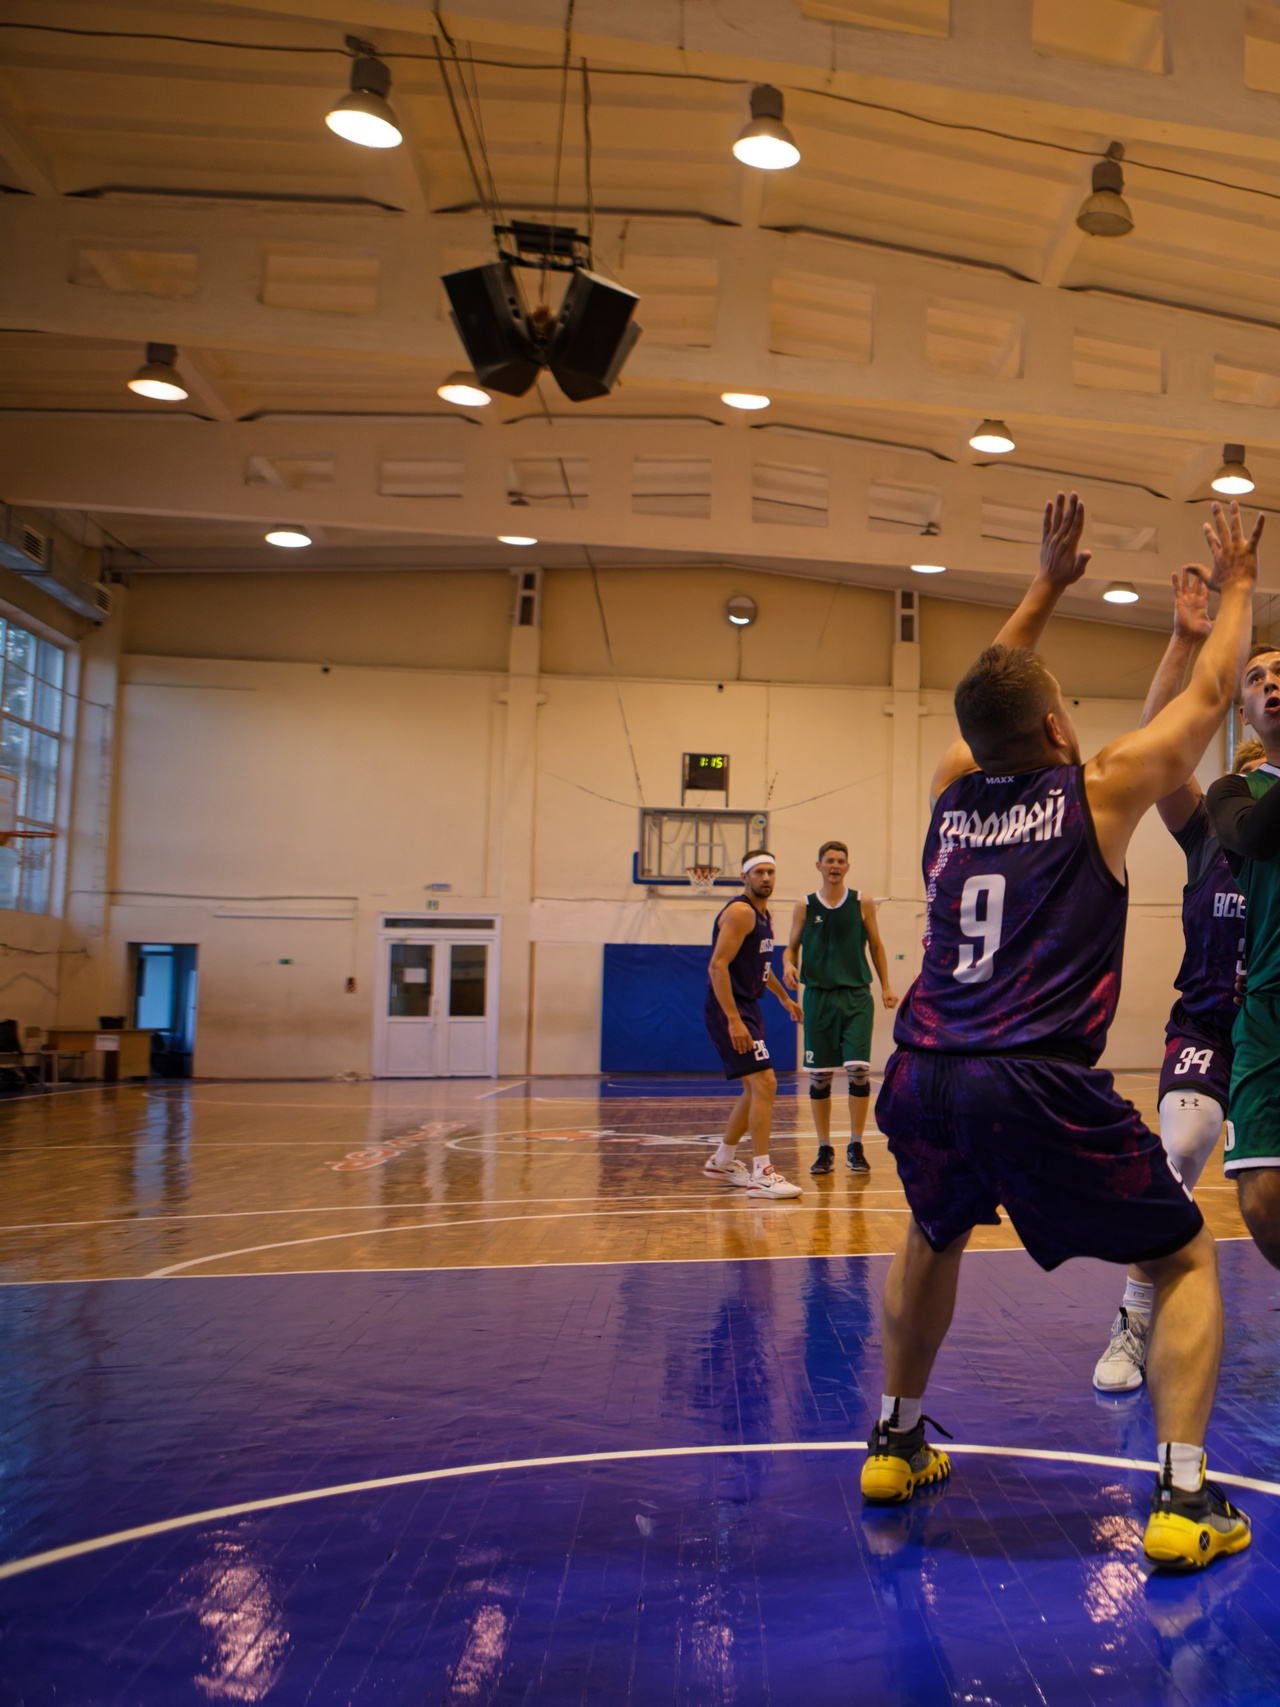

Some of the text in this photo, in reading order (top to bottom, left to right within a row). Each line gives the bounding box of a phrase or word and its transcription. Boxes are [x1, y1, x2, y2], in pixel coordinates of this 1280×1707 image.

[985, 776, 1015, 785] MAXX
[939, 788, 1066, 850] ТРАМВАЙ
[952, 873, 1006, 984] 9
[753, 1039, 770, 1061] 26
[1174, 1046, 1214, 1075] 34
